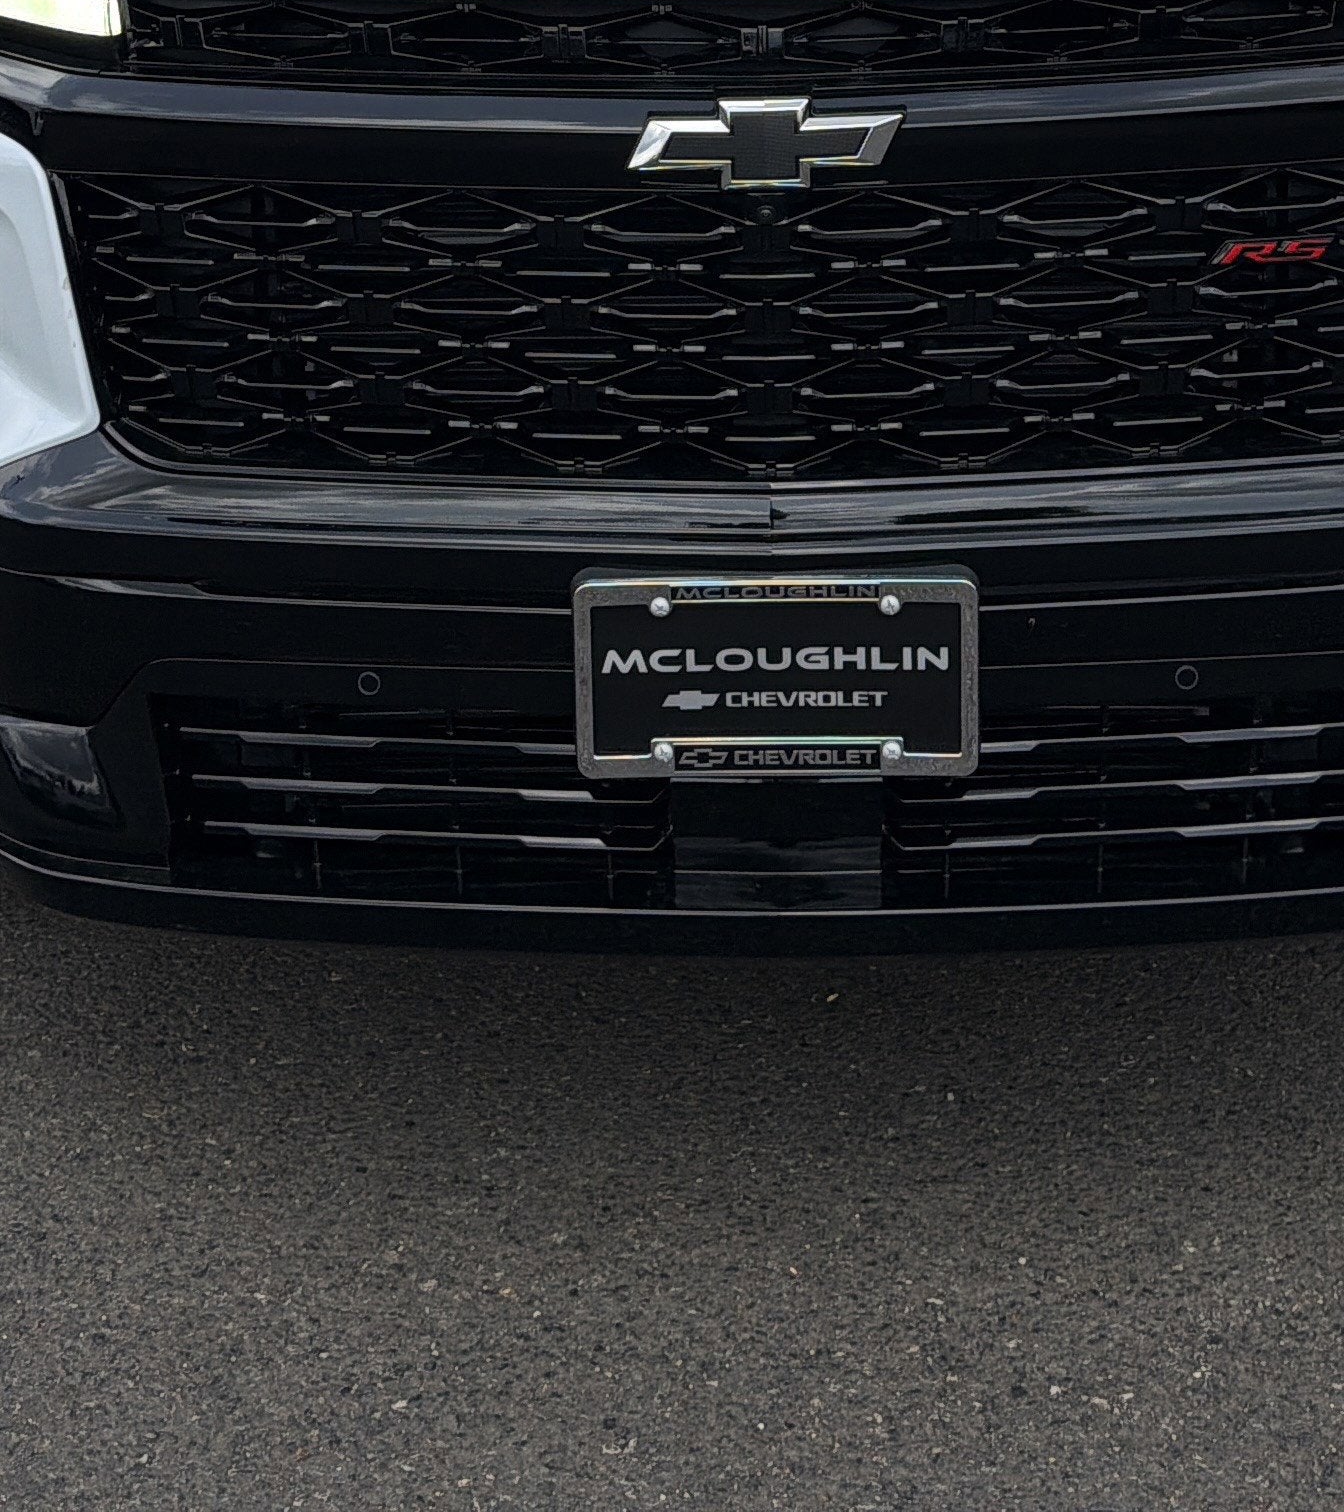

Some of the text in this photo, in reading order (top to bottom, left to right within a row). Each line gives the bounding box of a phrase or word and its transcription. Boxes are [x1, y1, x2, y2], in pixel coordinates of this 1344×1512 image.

[1210, 235, 1334, 265] RS
[674, 585, 880, 600] MCLOUGHLIN
[601, 645, 950, 675] MCLOUGHLIN
[724, 689, 889, 708] CHEVROLET
[733, 748, 878, 767] CHEVROLET
